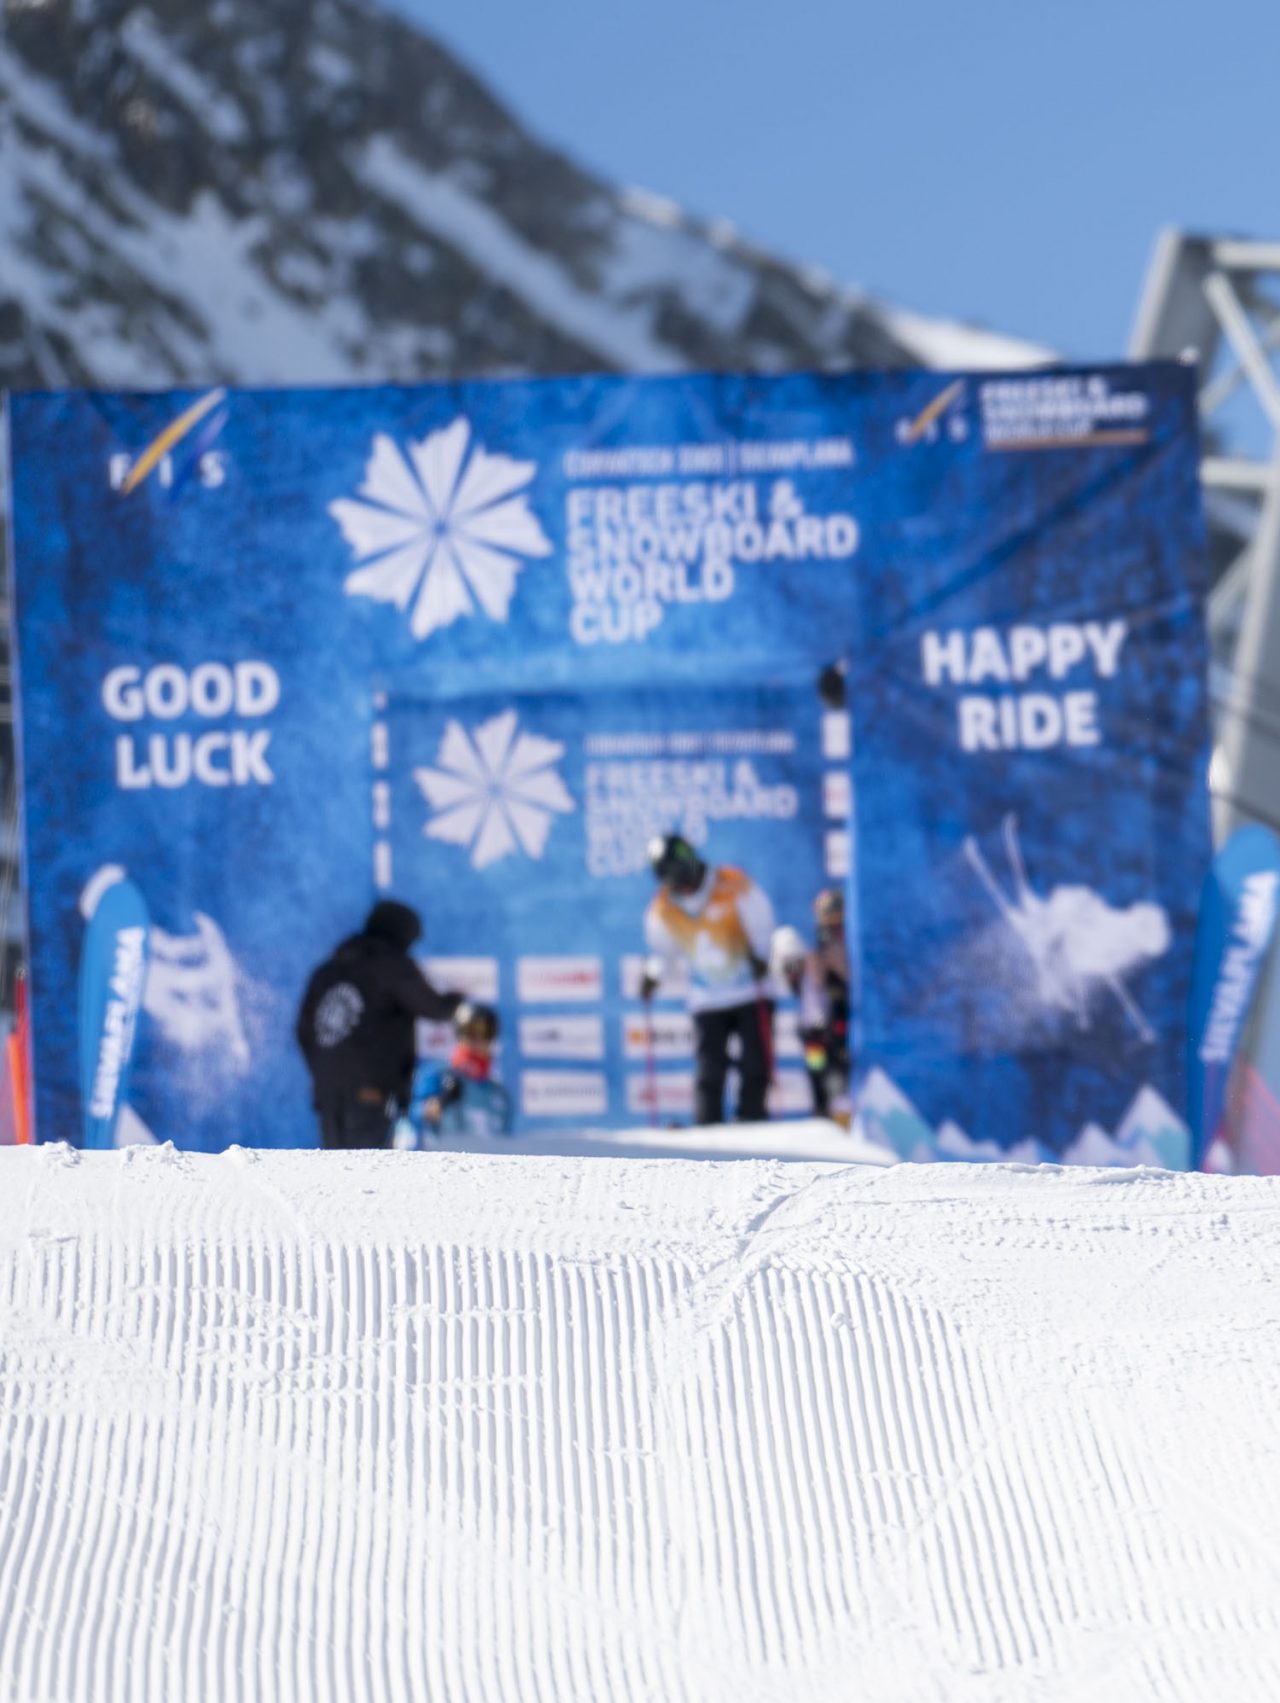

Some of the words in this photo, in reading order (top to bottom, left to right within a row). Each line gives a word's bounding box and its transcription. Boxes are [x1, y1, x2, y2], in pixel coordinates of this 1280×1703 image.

[567, 482, 757, 527] FREESKI
[770, 480, 804, 519] &
[567, 514, 858, 563] SNOWBOARD
[569, 557, 734, 603] WORLD
[570, 599, 663, 645] CUP
[921, 622, 1128, 686] HAPPY
[102, 661, 279, 721] GOOD
[959, 692, 1100, 752] RIDE
[117, 731, 273, 789] LUCK
